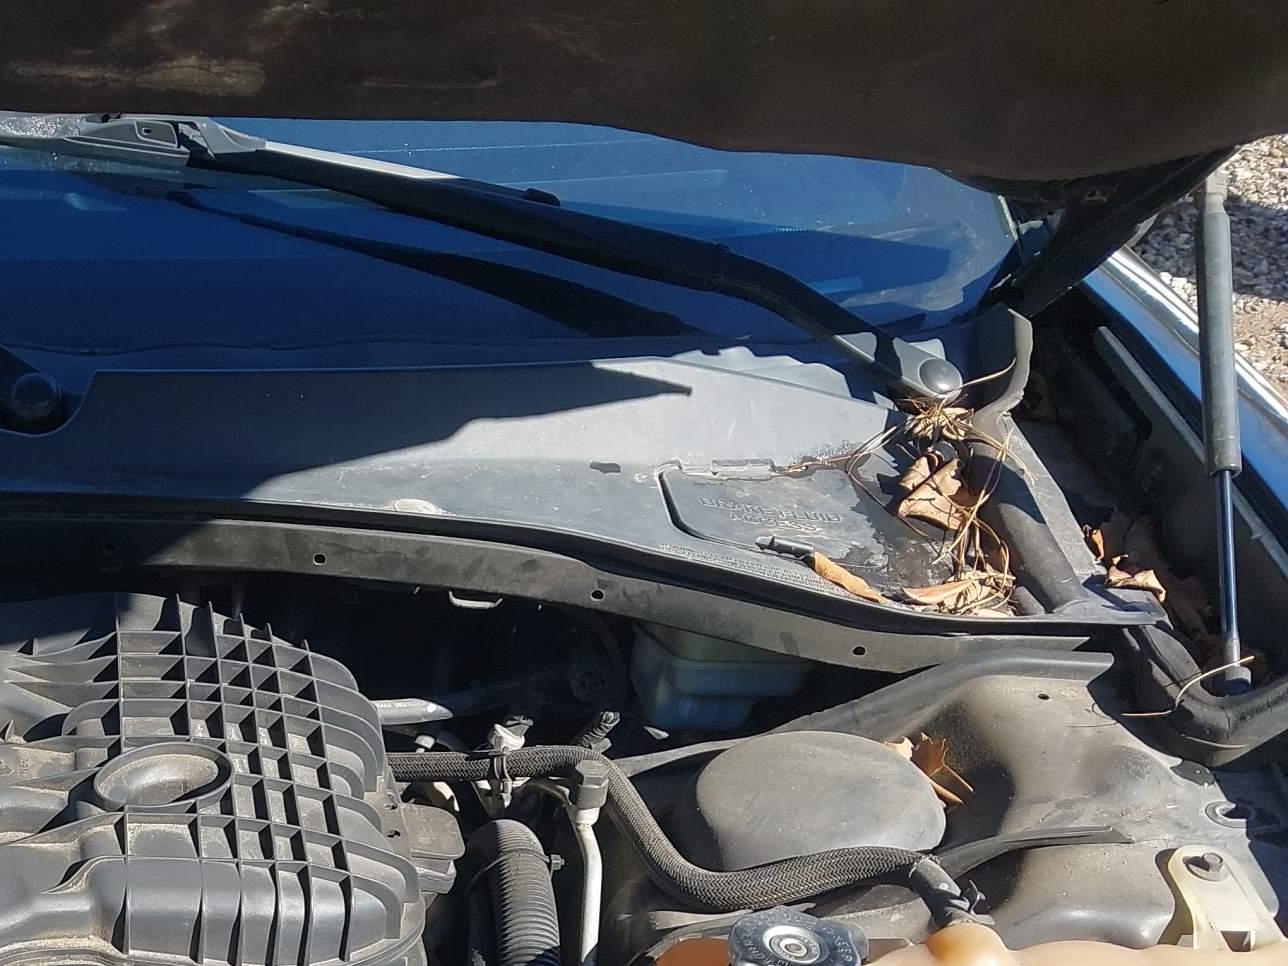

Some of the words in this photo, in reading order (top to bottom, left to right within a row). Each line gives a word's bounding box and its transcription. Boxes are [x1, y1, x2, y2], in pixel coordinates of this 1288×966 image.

[700, 496, 775, 518] BRAKE
[779, 509, 843, 523] FLUID
[730, 511, 824, 532] ACCESS
